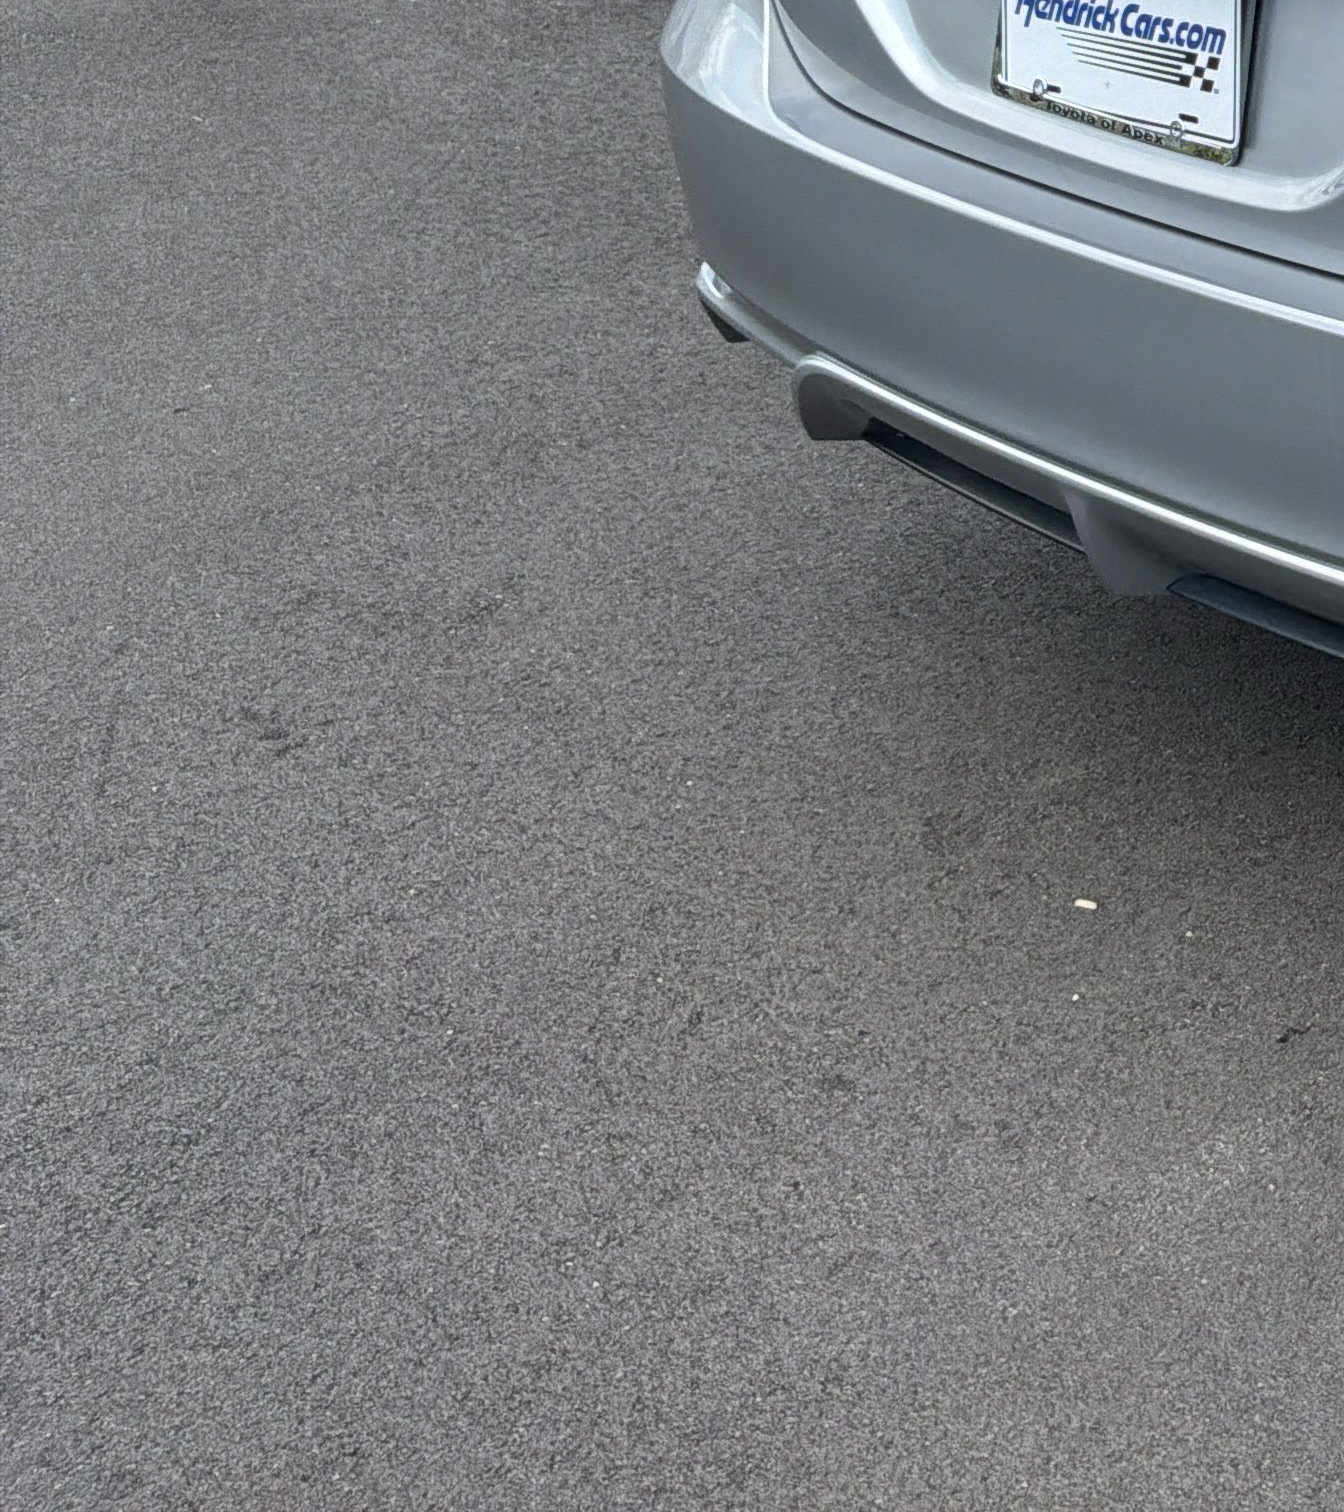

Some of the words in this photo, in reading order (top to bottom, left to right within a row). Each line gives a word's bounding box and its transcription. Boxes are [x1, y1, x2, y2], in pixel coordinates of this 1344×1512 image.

[1046, 101, 1097, 124] Toyota
[1101, 118, 1116, 131] of
[1121, 124, 1165, 146] Apex
